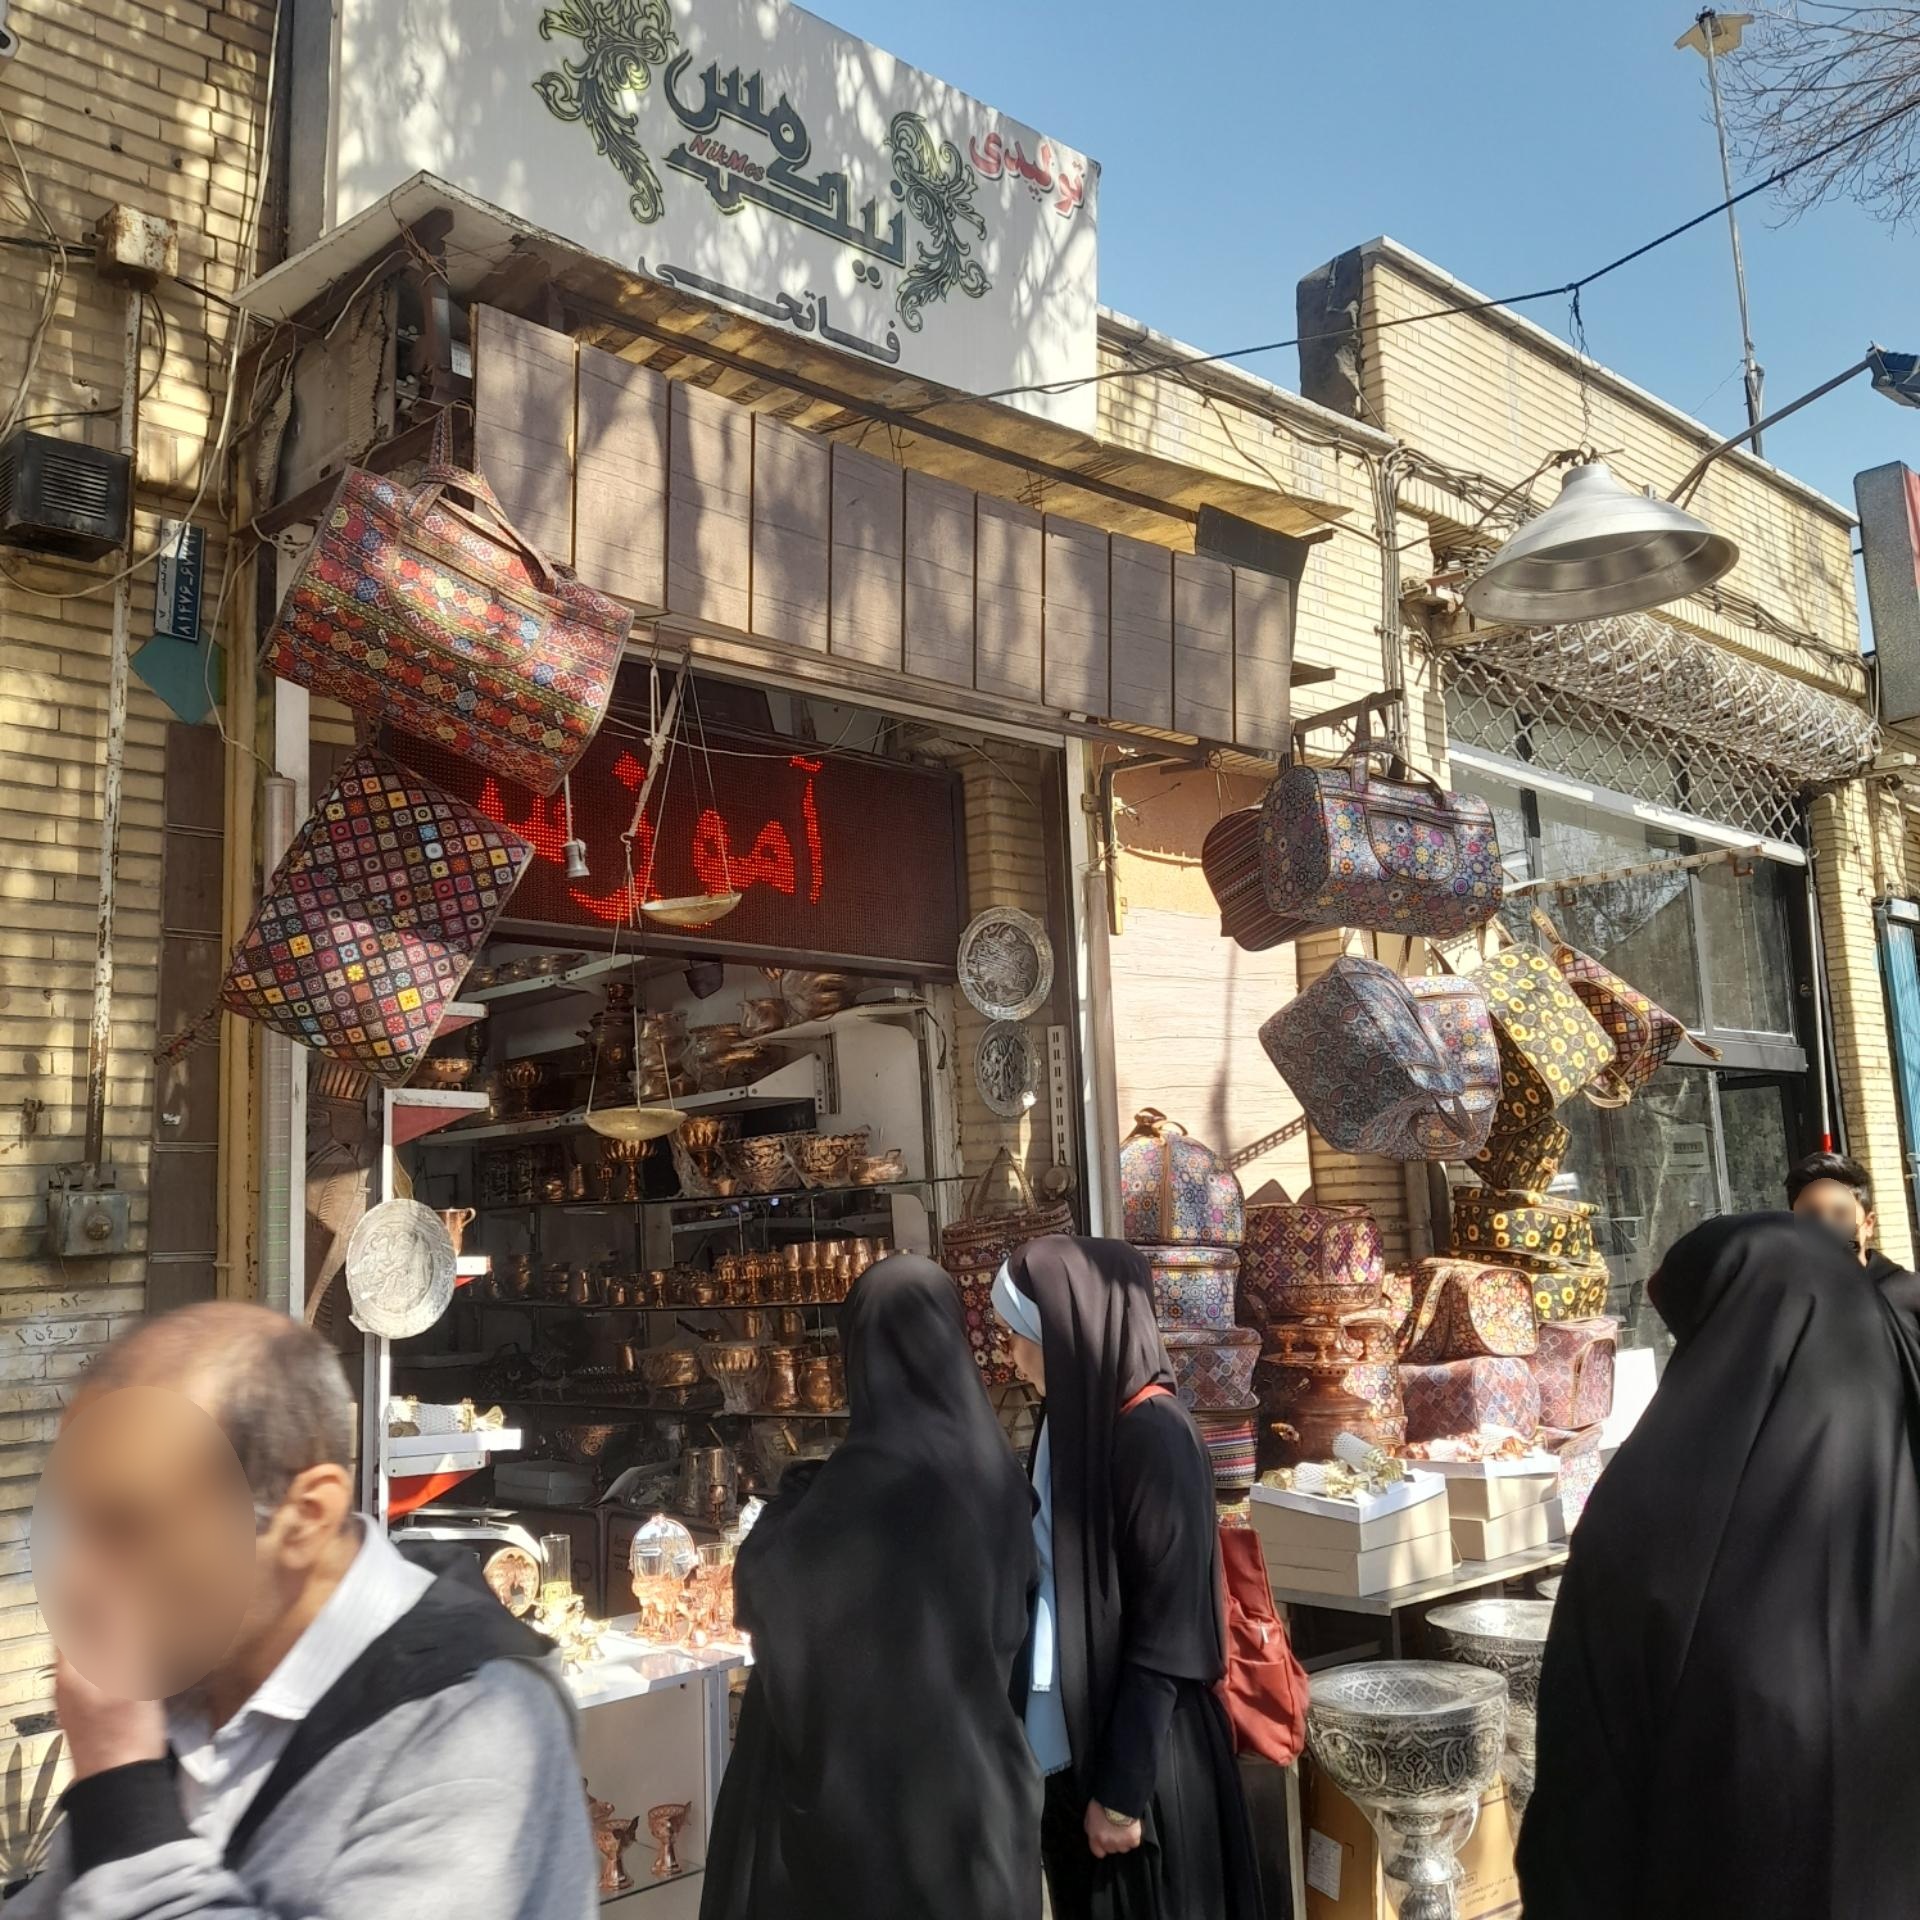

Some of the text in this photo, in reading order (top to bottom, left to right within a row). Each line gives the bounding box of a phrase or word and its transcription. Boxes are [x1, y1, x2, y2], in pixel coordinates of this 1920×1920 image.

[689, 134, 765, 182] NikMes
[969, 132, 1085, 219] تولیدی
[638, 256, 901, 364] فاتحی
